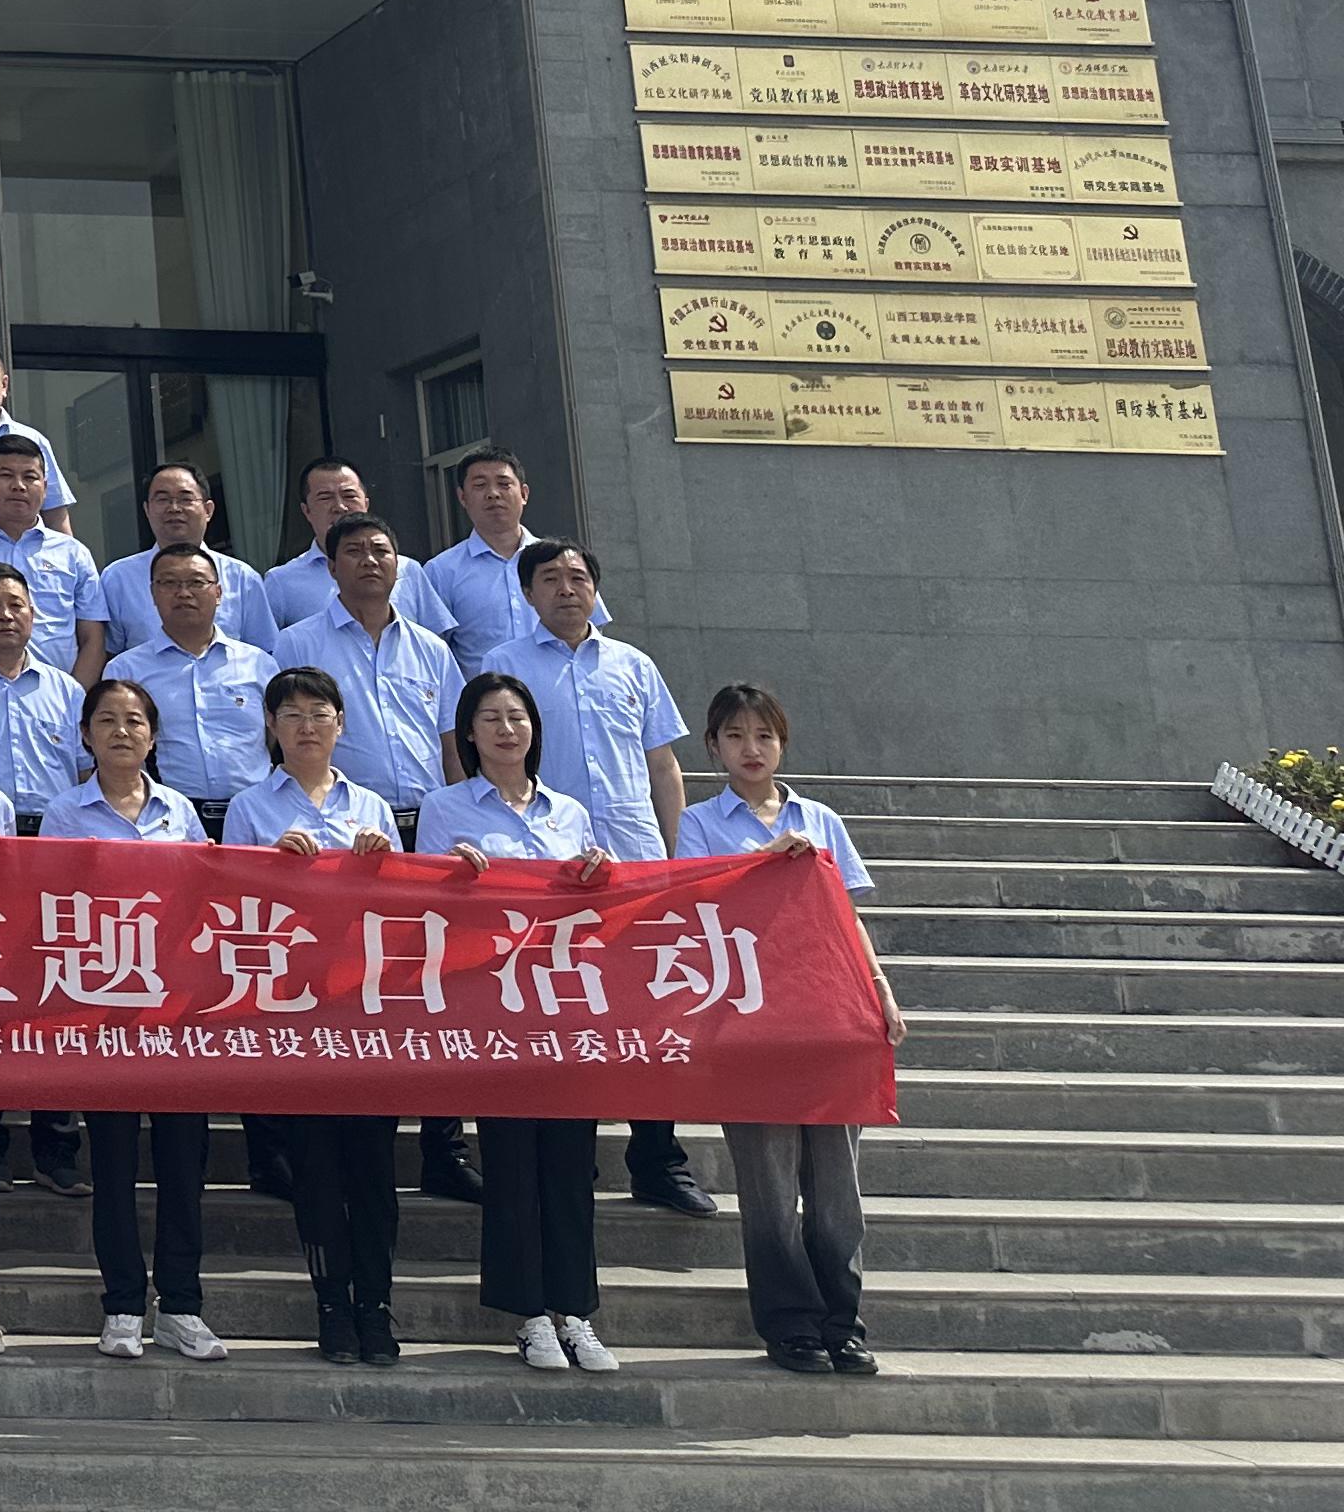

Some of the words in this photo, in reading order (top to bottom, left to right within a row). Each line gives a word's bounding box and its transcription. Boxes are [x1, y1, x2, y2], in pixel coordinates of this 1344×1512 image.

[1052, 7, 1141, 22] 红色文化教育基地
[641, 52, 731, 83] 山西延安精神研究会
[644, 86, 733, 100] 红色文化研学基地
[750, 87, 841, 105] 党员教育基地
[853, 79, 945, 101] 思想政治教育基地
[958, 81, 1050, 104] 革命文化研究基地
[1061, 86, 1155, 103] 思想政治教育实践基地
[652, 144, 742, 161] 思想政治教育实践基地
[864, 145, 915, 156] 思想政治教育
[916, 150, 955, 166] 实践基地
[759, 154, 848, 168] 思想政治教育基地
[865, 156, 917, 168] 爱国主义教育
[969, 155, 1062, 174] 思政实训基地
[1083, 180, 1165, 193] 研究生实践基地
[661, 237, 755, 255] 思想政治教育实践基地
[772, 234, 856, 248] 大学生思想政治
[773, 248, 858, 262] 教育基地
[985, 243, 1069, 257] 红色法治文化基地
[894, 260, 952, 272] 教育实践基地
[669, 296, 766, 329] 中国工商银行山西省分行
[885, 311, 977, 324] 山西工程职业学院
[994, 317, 1087, 335] 全市法院党性教育基地
[683, 339, 759, 352] 党性教育基地
[889, 334, 981, 346] 爱国主义教育基地
[1106, 337, 1198, 359] 思政教育实践基地
[907, 399, 985, 413] 思想政治教育
[1115, 398, 1207, 421] 国防教育基地
[684, 407, 775, 422] 思想政治教育基地
[922, 413, 974, 425] 实践基地
[1010, 406, 1099, 423] 思想政治教育基地
